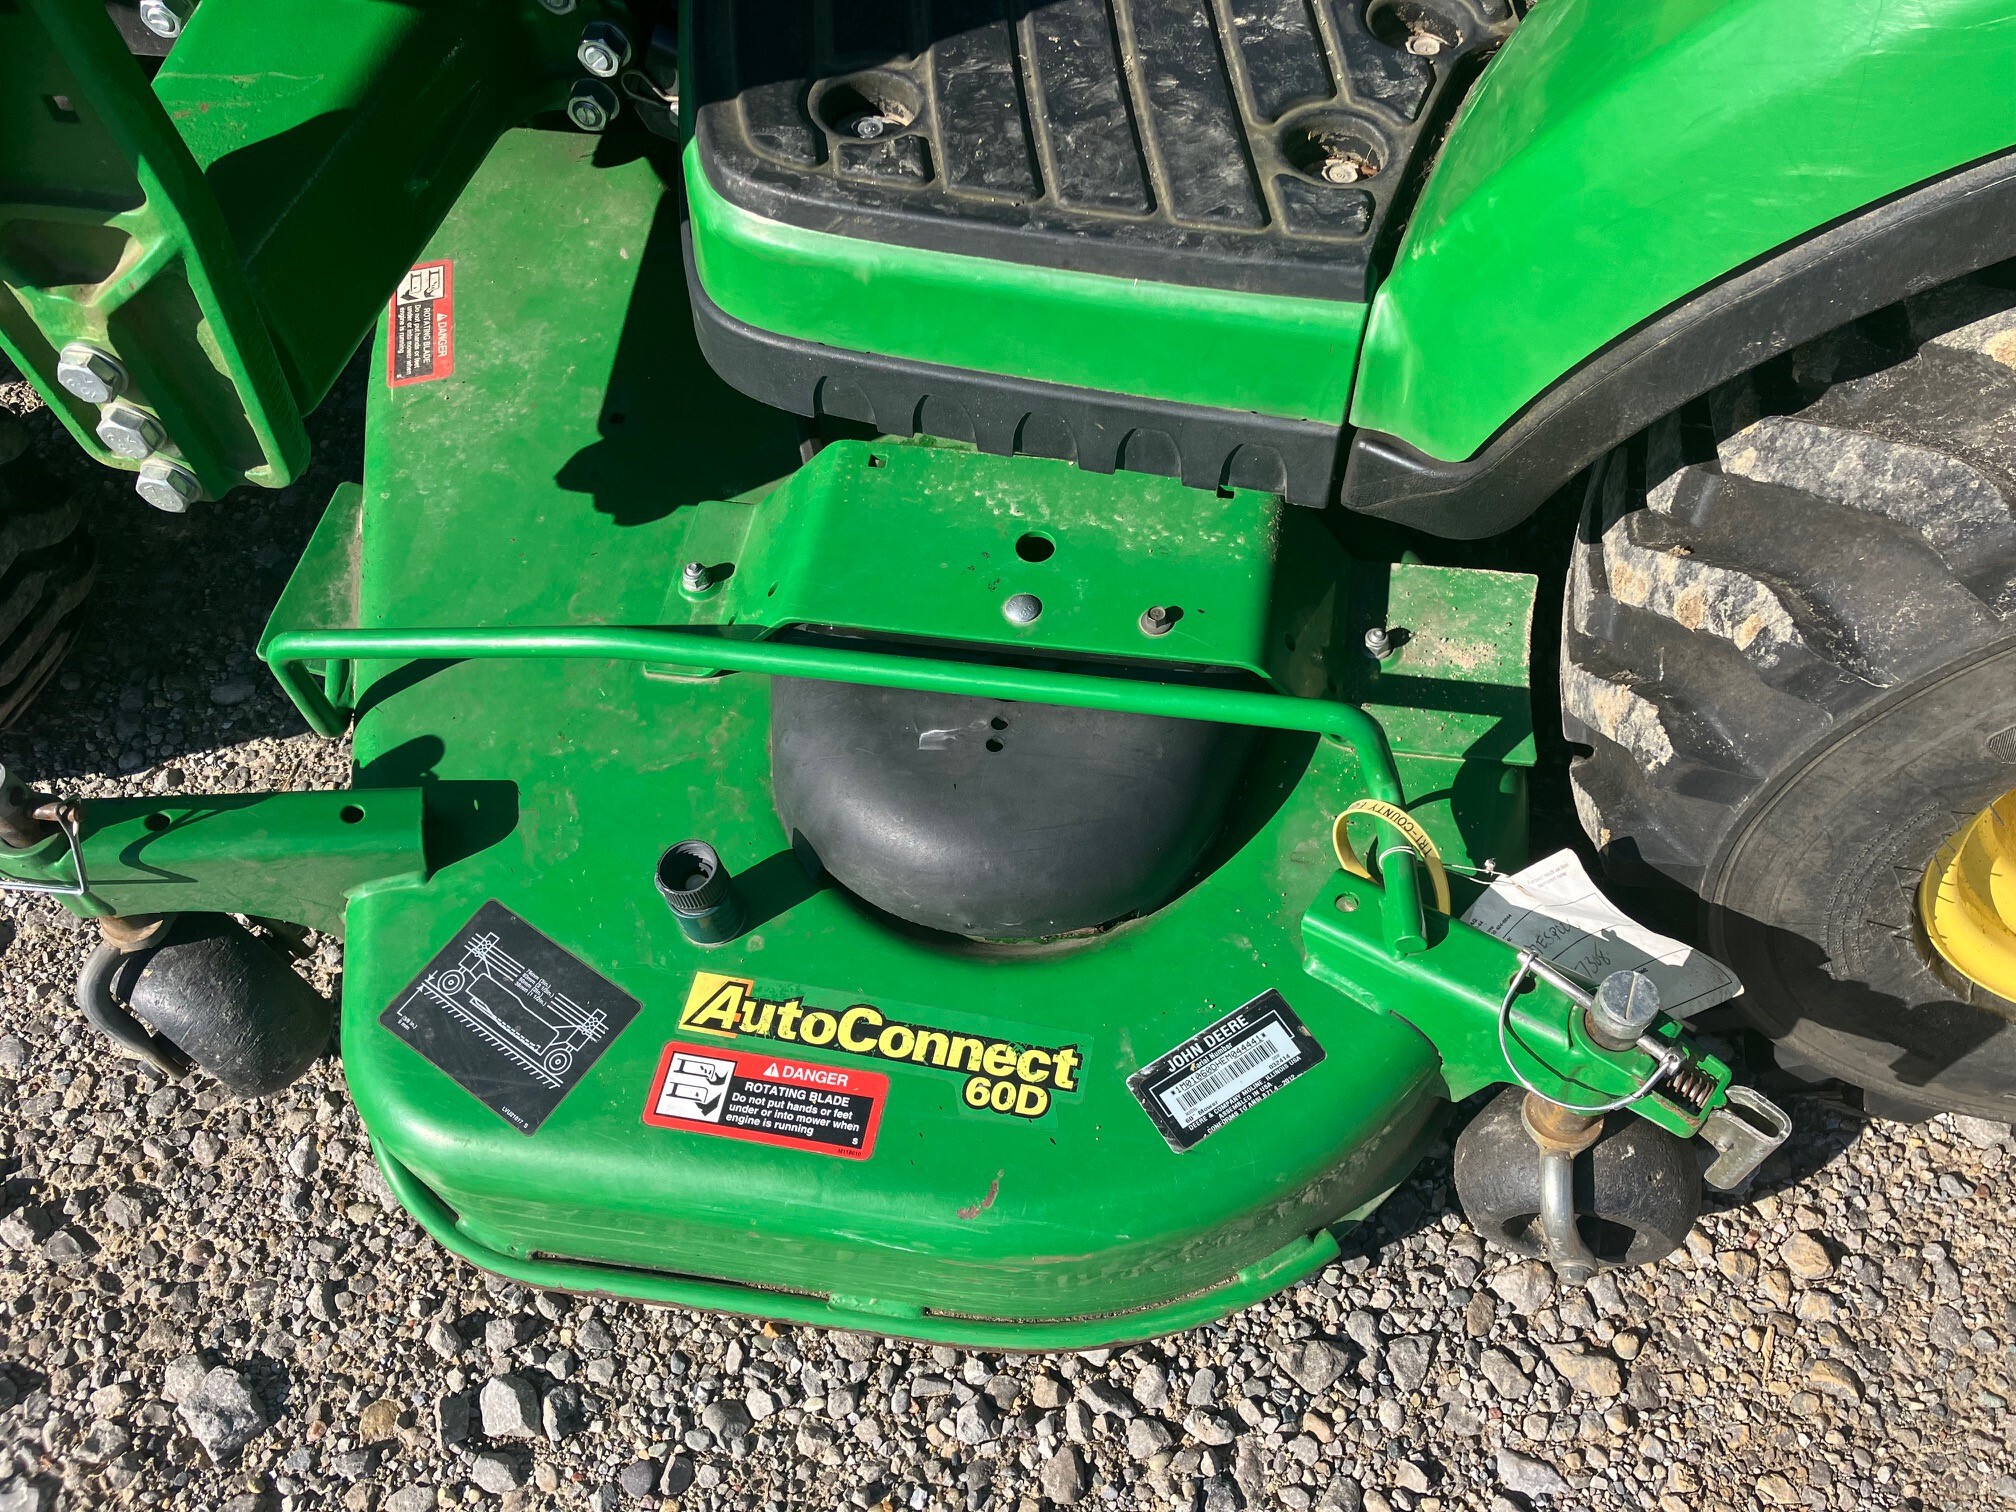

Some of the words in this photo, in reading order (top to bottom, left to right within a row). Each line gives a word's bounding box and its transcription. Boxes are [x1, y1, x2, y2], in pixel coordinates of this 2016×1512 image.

[438, 322, 447, 357] DANGER
[1370, 804, 1432, 857] TRI-COUNTY
[694, 980, 1079, 1090] AutoConnect
[1167, 1043, 1202, 1072] JOHN
[1204, 1015, 1248, 1047] DEERE
[1209, 1043, 1232, 1059] Number
[1269, 1054, 1290, 1069] 032414
[783, 1066, 848, 1086] DANGER
[732, 1093, 746, 1102] Do
[751, 1097, 765, 1106] not
[767, 1100, 784, 1110] put
[787, 1102, 817, 1114] hands
[834, 1109, 852, 1120] feet
[745, 1082, 806, 1099] ROTATING
[809, 1092, 850, 1107] BLADE
[964, 1077, 1049, 1115] 60D
[1188, 1116, 1208, 1130] DEERE
[1214, 1094, 1241, 1114] COMPANY
[1265, 1064, 1288, 1081] ILLINOIS
[1288, 1056, 1301, 1065] USA
[1219, 1095, 1252, 1119] ASSEMBLED
[1259, 1082, 1272, 1092] USA
[726, 1114, 760, 1125] engine
[762, 1119, 771, 1127] is
[774, 1122, 814, 1136] running
[729, 1104, 758, 1114] under
[774, 1110, 794, 1120] into
[796, 1115, 830, 1126] mower
[833, 1121, 859, 1131] when
[1207, 1111, 1239, 1134] CONFORMS
[1238, 1104, 1248, 1113] TO
